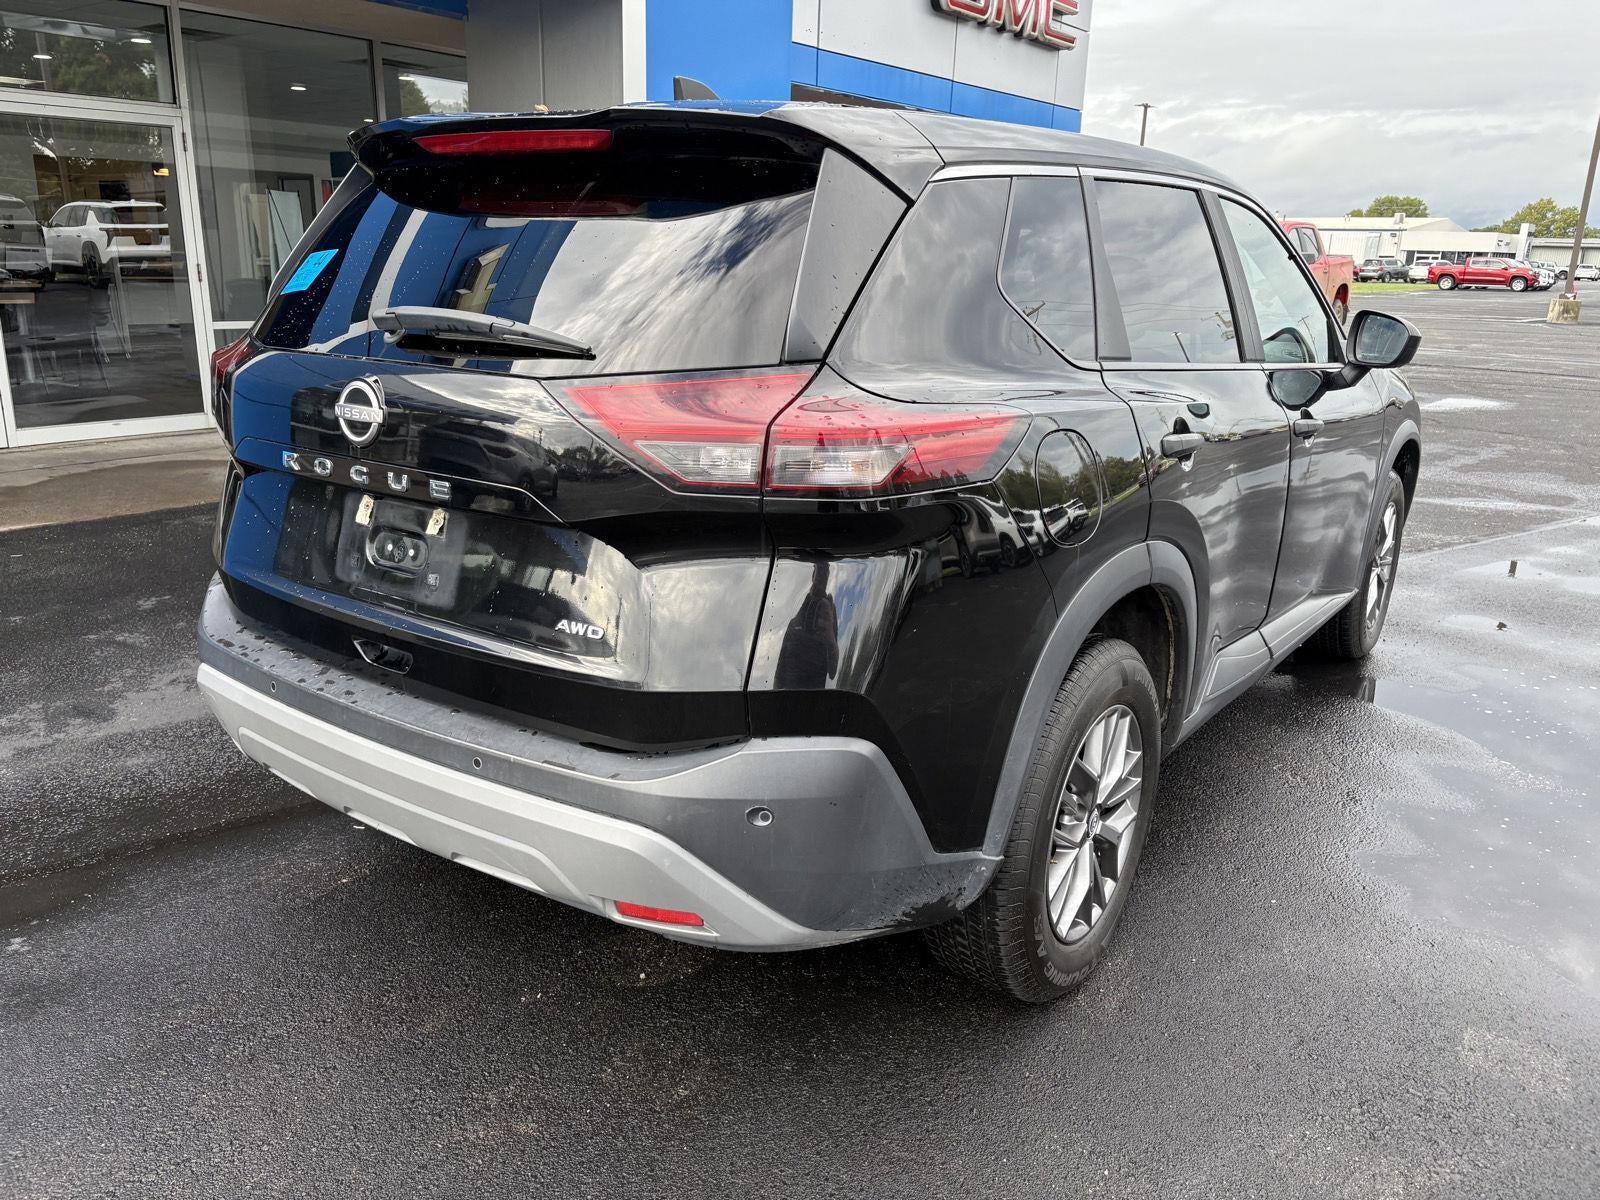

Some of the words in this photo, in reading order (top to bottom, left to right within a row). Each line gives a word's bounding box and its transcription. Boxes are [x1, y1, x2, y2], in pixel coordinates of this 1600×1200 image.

[335, 405, 383, 423] NISSAN
[283, 451, 452, 501] ROGUE
[555, 619, 605, 640] AWD
